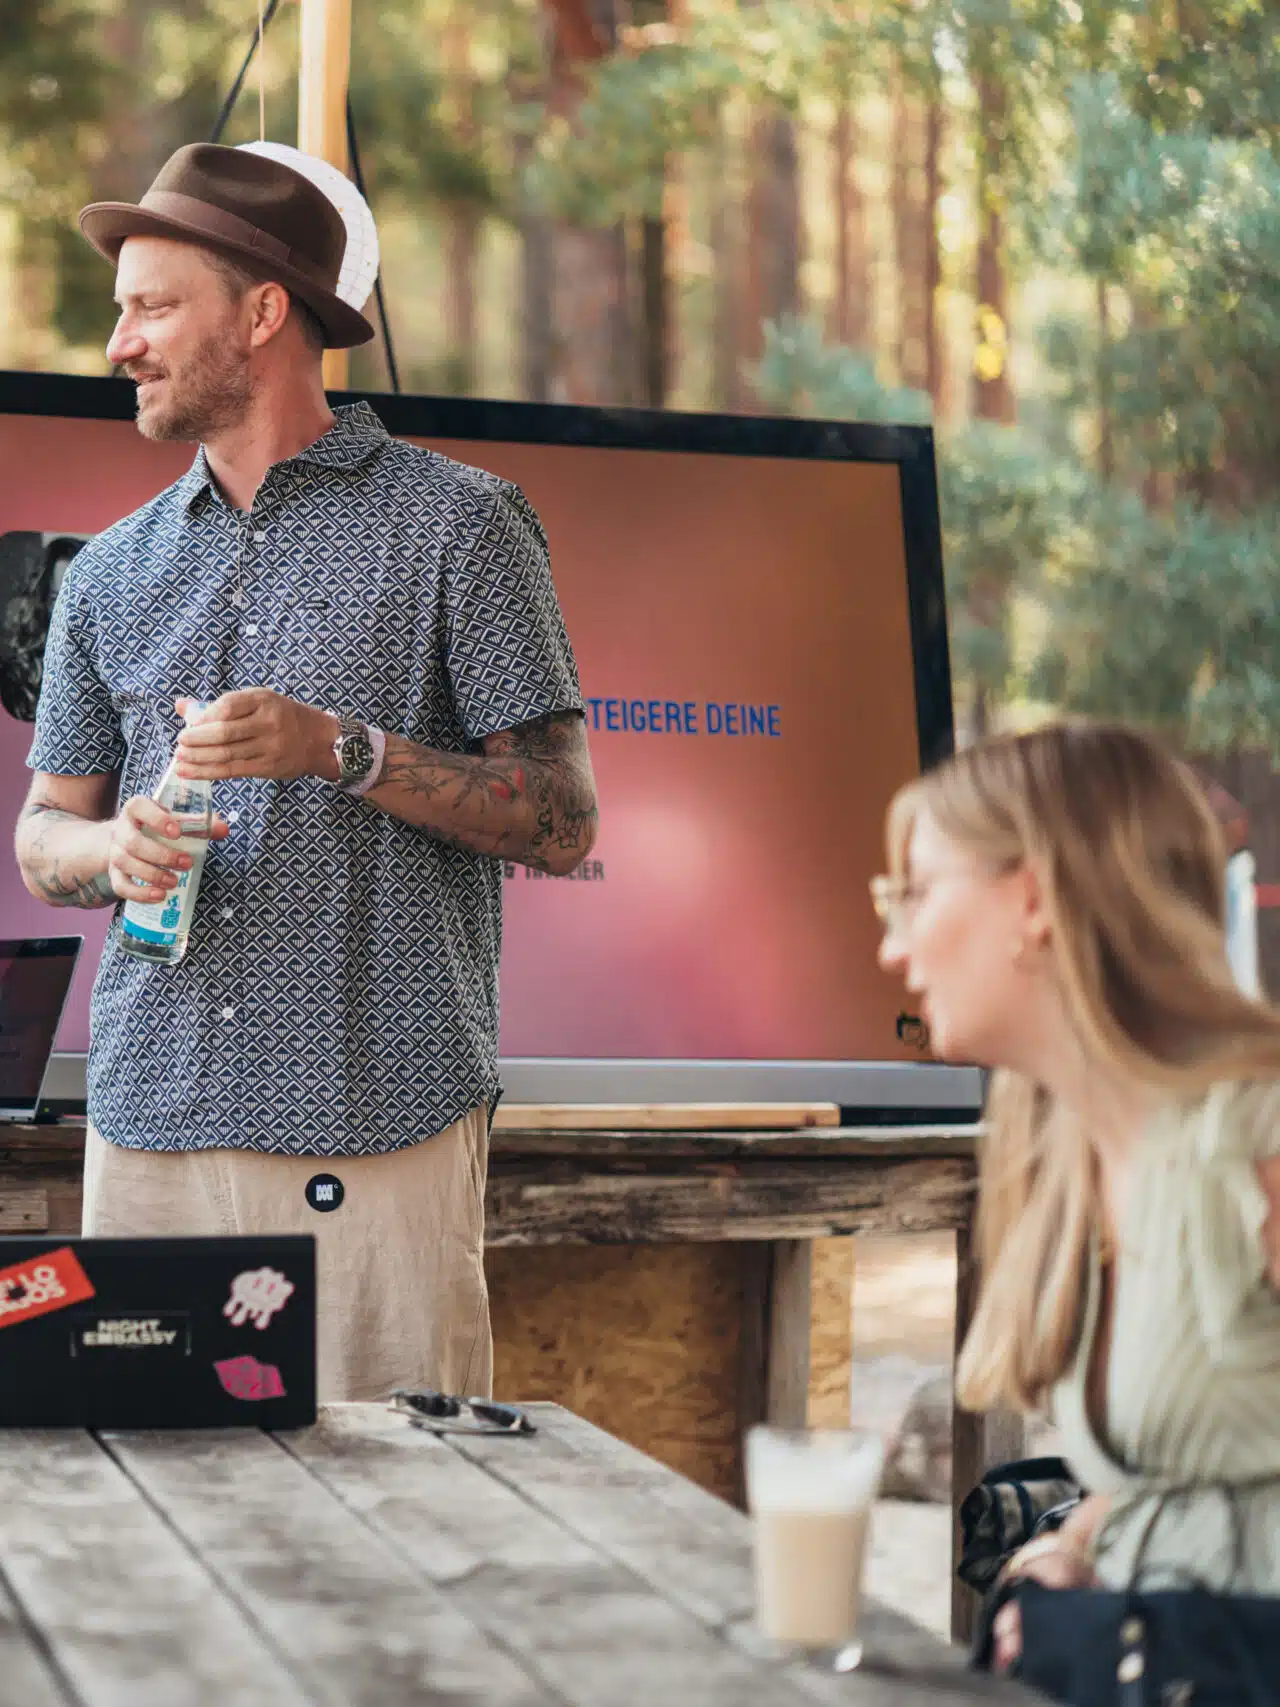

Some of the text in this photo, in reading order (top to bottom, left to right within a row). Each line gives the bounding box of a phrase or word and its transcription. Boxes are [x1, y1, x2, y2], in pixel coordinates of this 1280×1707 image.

[584, 698, 781, 736] TEIGERE DEINE
[97, 1319, 159, 1332] NIGHT
[83, 1331, 176, 1345] EMBASSY
